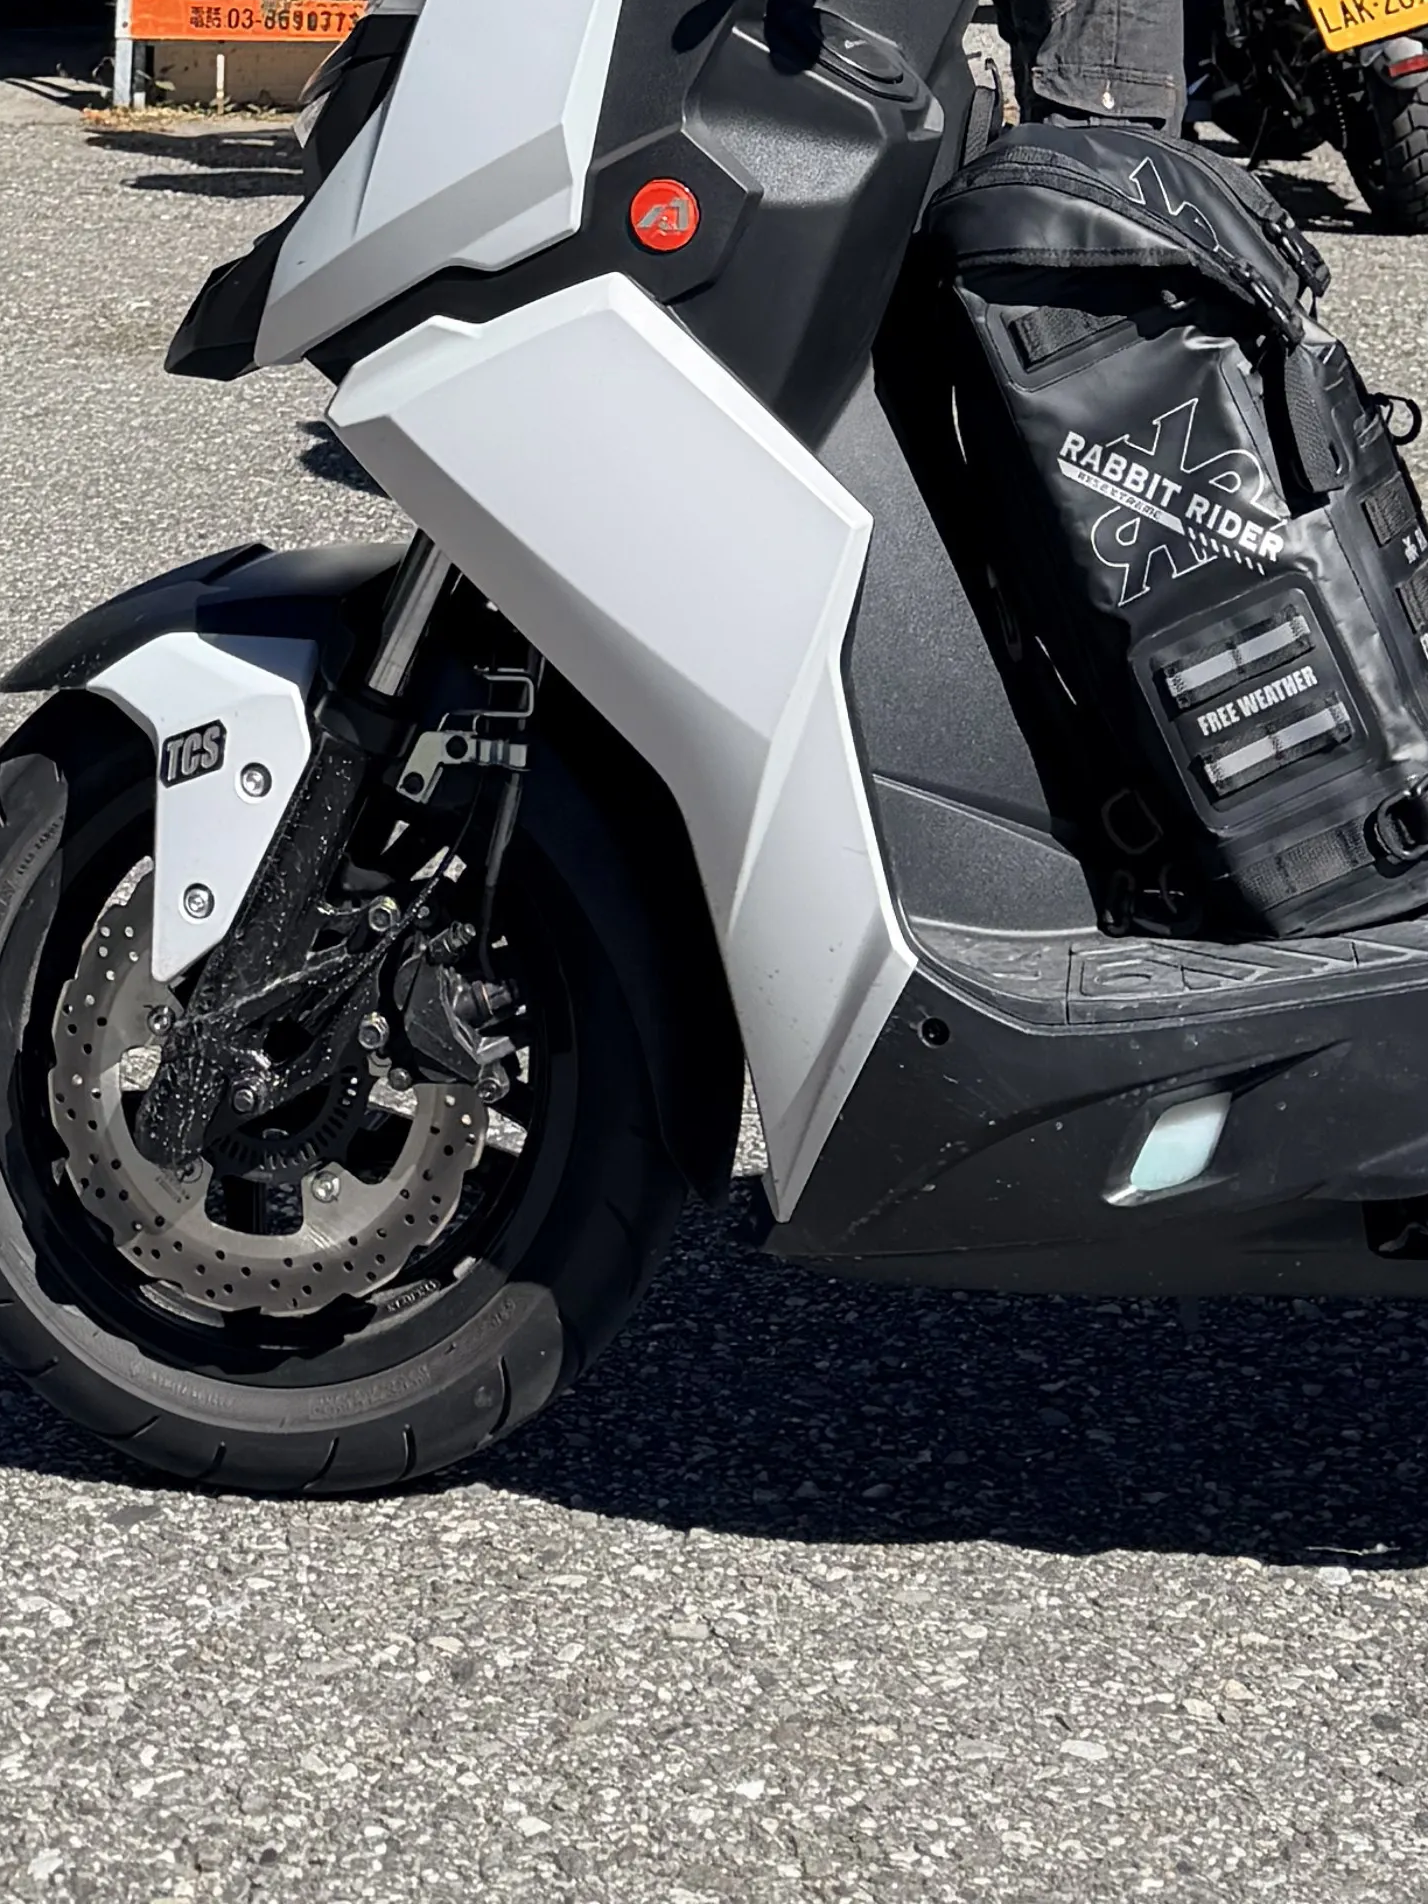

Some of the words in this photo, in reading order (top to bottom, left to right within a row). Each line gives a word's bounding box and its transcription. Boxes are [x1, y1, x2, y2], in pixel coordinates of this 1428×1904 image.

[1059, 431, 1184, 508] RABBIT
[1185, 493, 1286, 562] RIDER
[1196, 702, 1241, 737] FREE
[1236, 665, 1318, 718] WEATHER
[167, 725, 221, 781] TCS
